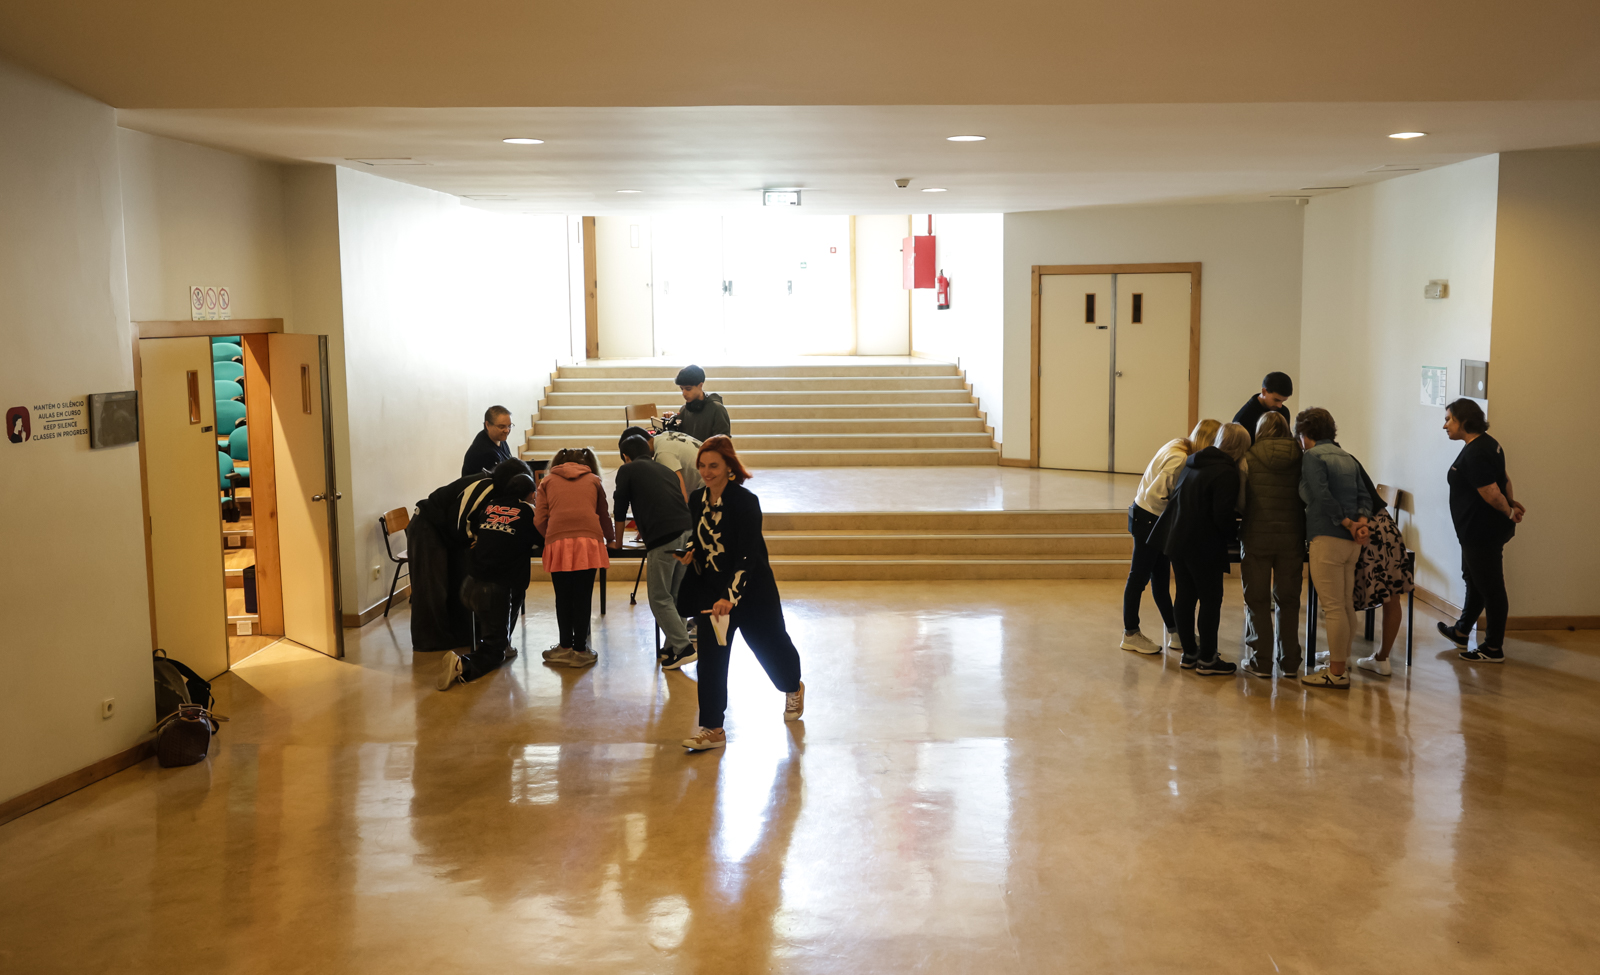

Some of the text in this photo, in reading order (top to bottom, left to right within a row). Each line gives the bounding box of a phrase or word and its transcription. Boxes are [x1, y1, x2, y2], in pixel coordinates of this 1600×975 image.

[62, 400, 84, 408] SILÊNCIO
[33, 432, 55, 441] CLASSES
[63, 428, 88, 437] PROGRESS
[486, 514, 520, 524] DAY
